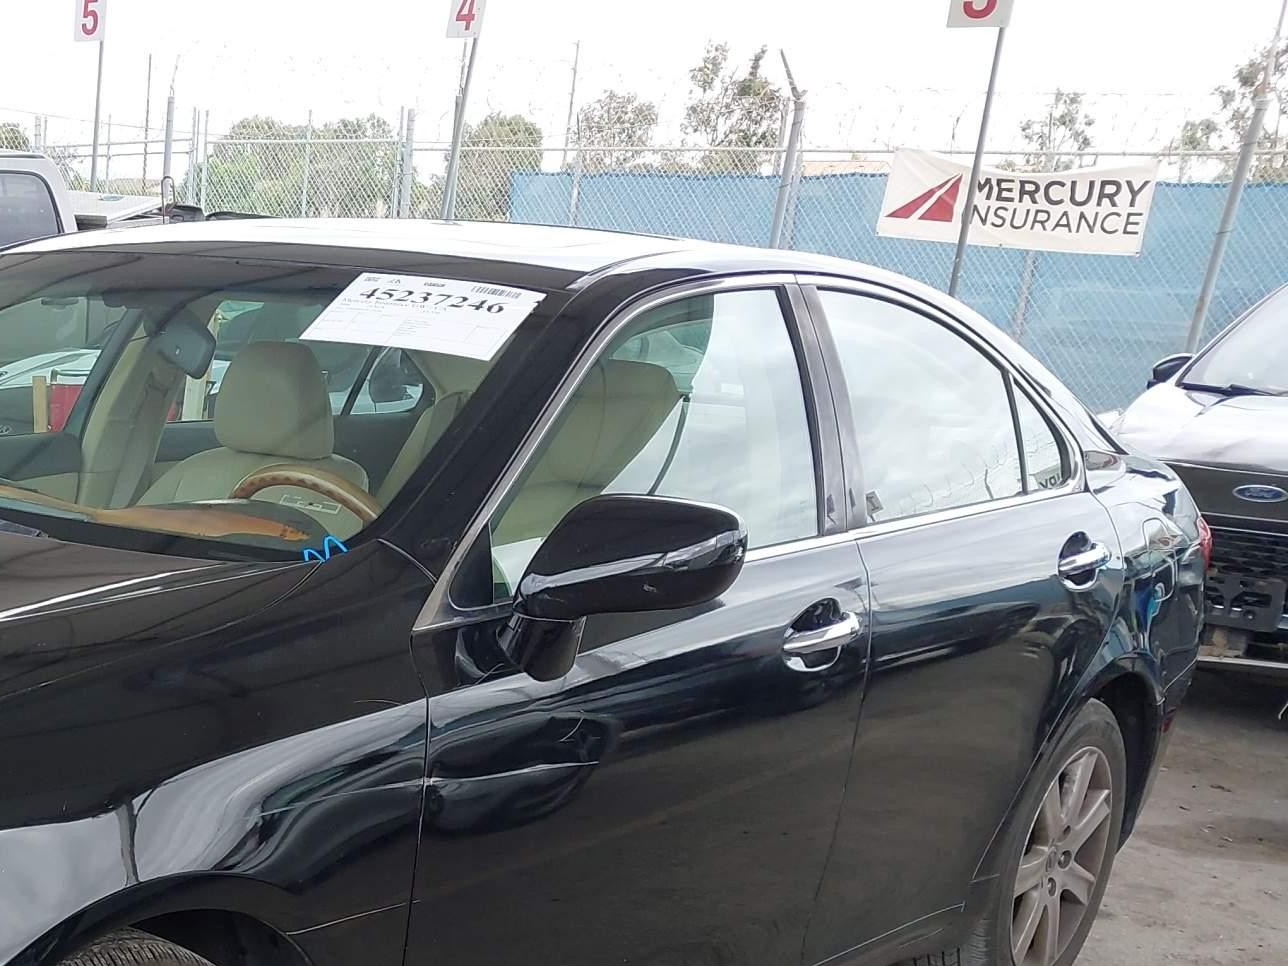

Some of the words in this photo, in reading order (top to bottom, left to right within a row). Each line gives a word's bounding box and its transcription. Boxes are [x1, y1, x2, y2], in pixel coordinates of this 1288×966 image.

[81, 0, 99, 35] 5
[455, 0, 475, 31] 4
[969, 204, 1143, 235] NSURANCE
[359, 286, 505, 314] 45237246
